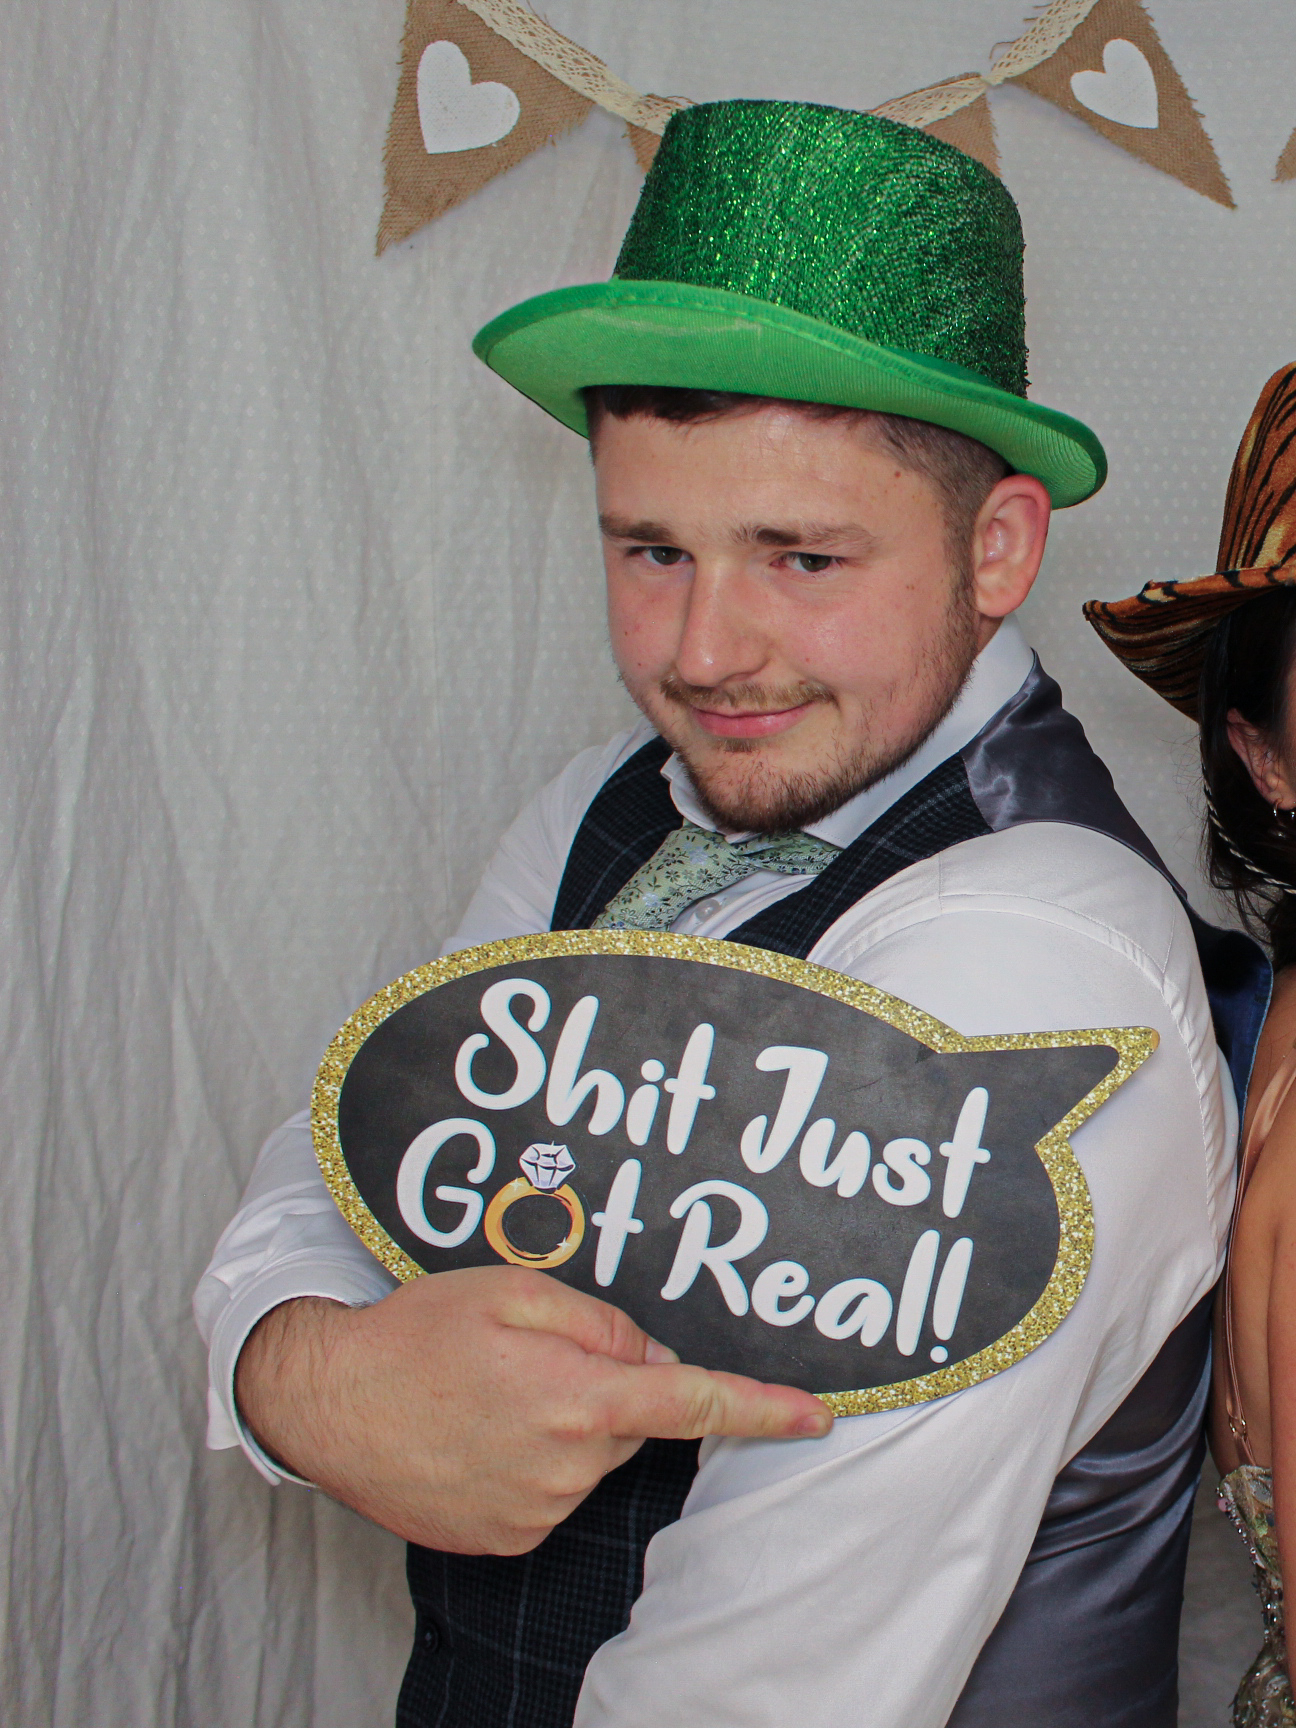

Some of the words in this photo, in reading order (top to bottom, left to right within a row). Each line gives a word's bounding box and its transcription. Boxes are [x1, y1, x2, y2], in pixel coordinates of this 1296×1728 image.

[455, 978, 716, 1155] Shit
[740, 1045, 990, 1218] Just
[661, 1180, 974, 1363] Real!
